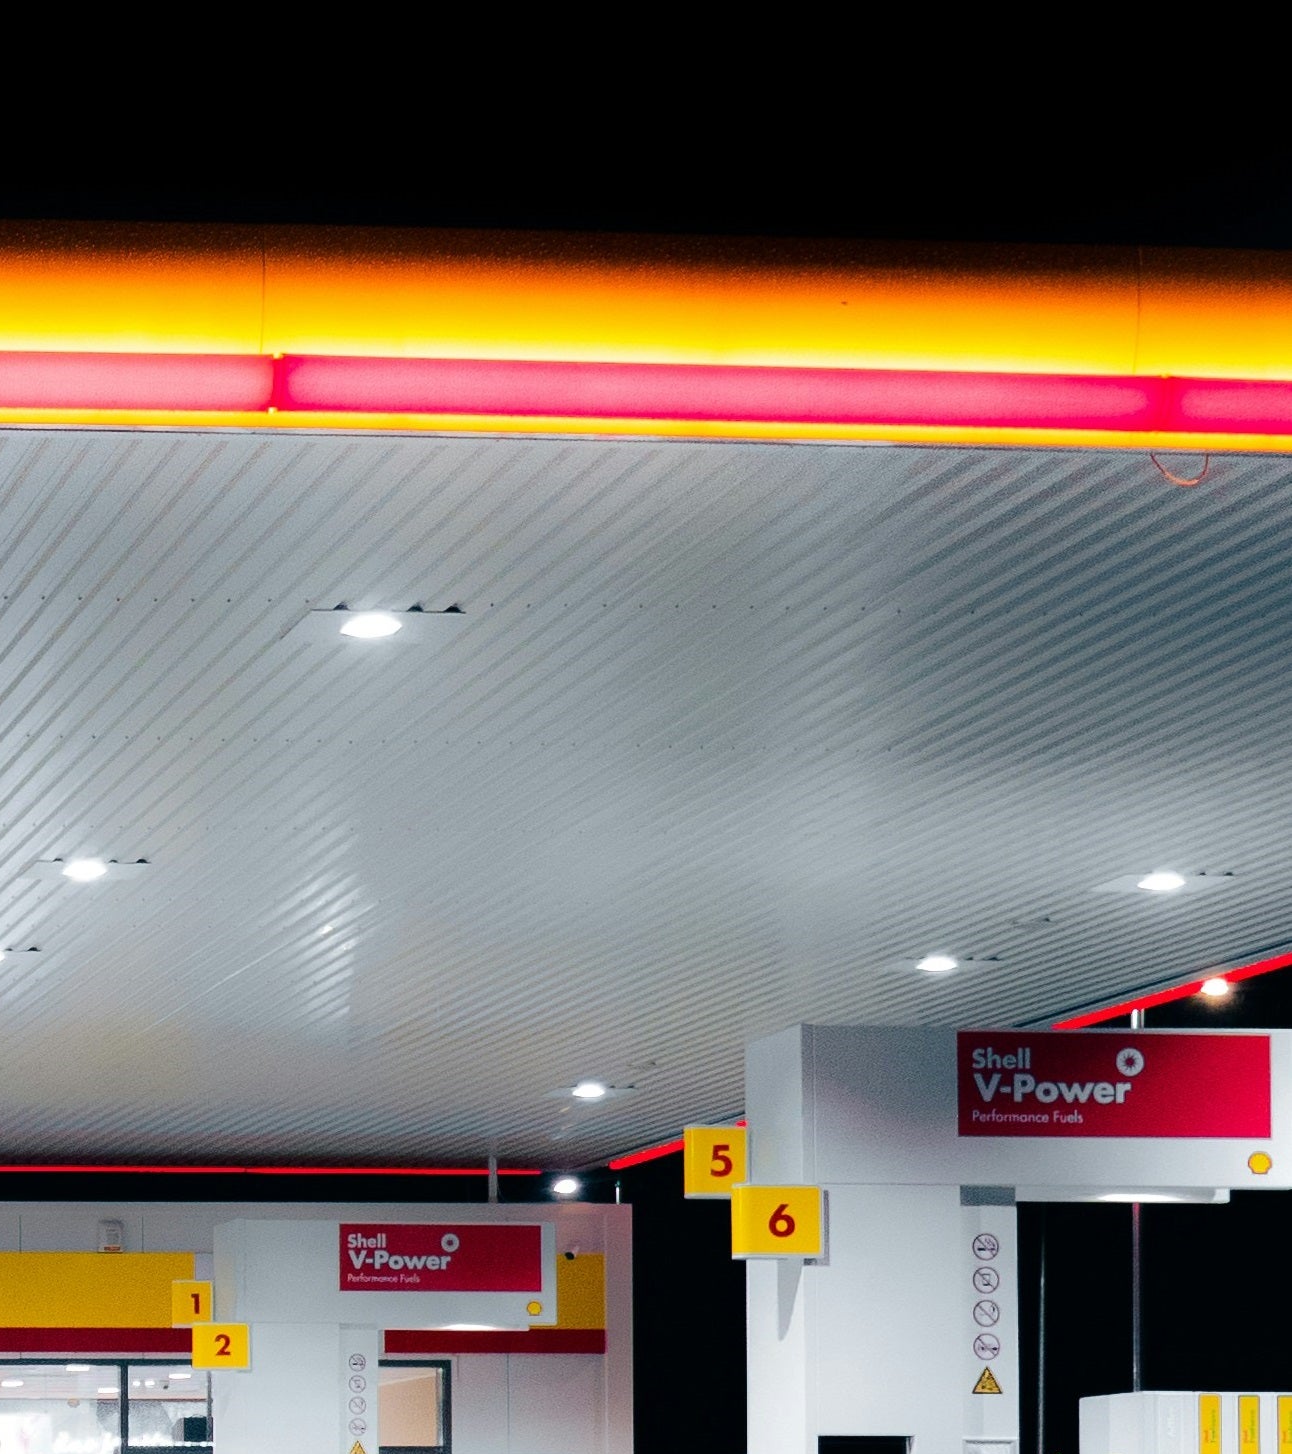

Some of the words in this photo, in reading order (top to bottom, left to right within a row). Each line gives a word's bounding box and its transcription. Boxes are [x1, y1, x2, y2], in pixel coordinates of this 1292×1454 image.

[972, 1047, 1031, 1069] Shell
[973, 1073, 1132, 1104] V-Power
[972, 1108, 1049, 1123] Performance
[1053, 1109, 1084, 1124] Fuels
[710, 1144, 733, 1177] 5
[768, 1203, 795, 1237] 6
[347, 1233, 386, 1248] Shell
[348, 1250, 451, 1270] V-Power
[347, 1273, 398, 1283] Performance
[400, 1273, 420, 1283] Fuels
[191, 1292, 200, 1315] 1
[214, 1333, 232, 1356] 2
